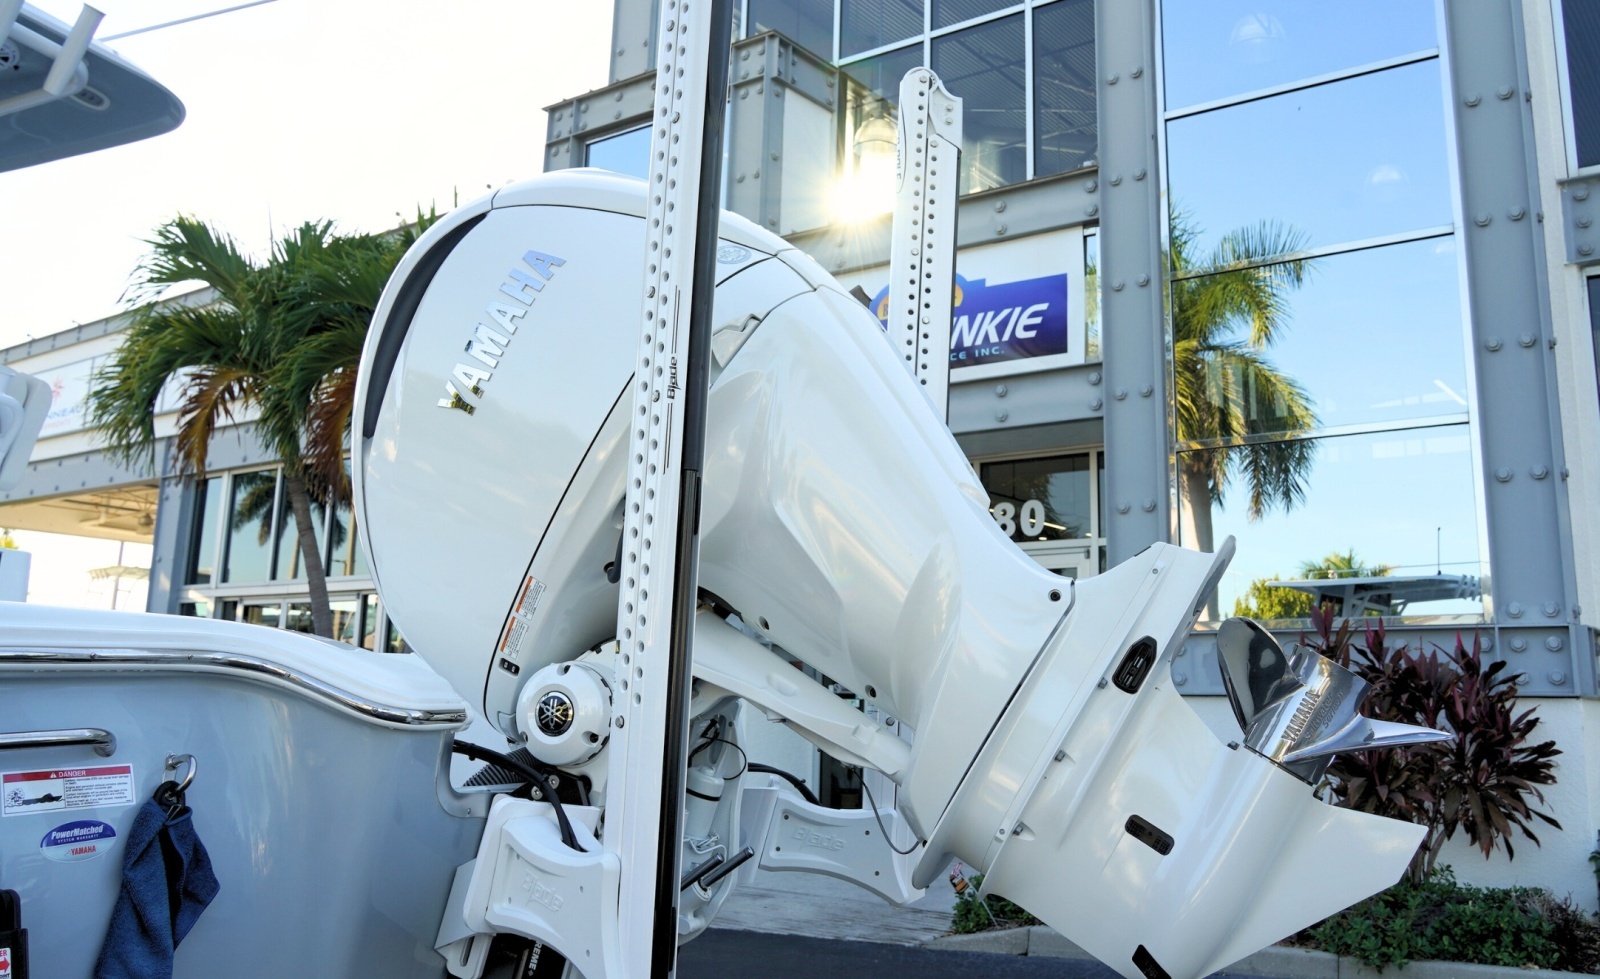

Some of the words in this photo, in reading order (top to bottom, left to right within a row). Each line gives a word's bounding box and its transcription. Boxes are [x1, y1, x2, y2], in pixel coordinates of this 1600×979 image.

[437, 249, 567, 416] YAMAHA
[951, 303, 1050, 349] NKIE
[950, 350, 967, 361] CE
[975, 346, 1005, 357] INC.
[667, 356, 681, 399] Blade
[47, 404, 82, 419] NNEAU
[1281, 691, 1322, 742] YAMAHA
[58, 769, 87, 778] DANGER
[51, 824, 104, 840] PowerMatched
[70, 845, 97, 856] YAMAHA
[529, 942, 543, 971] REME
